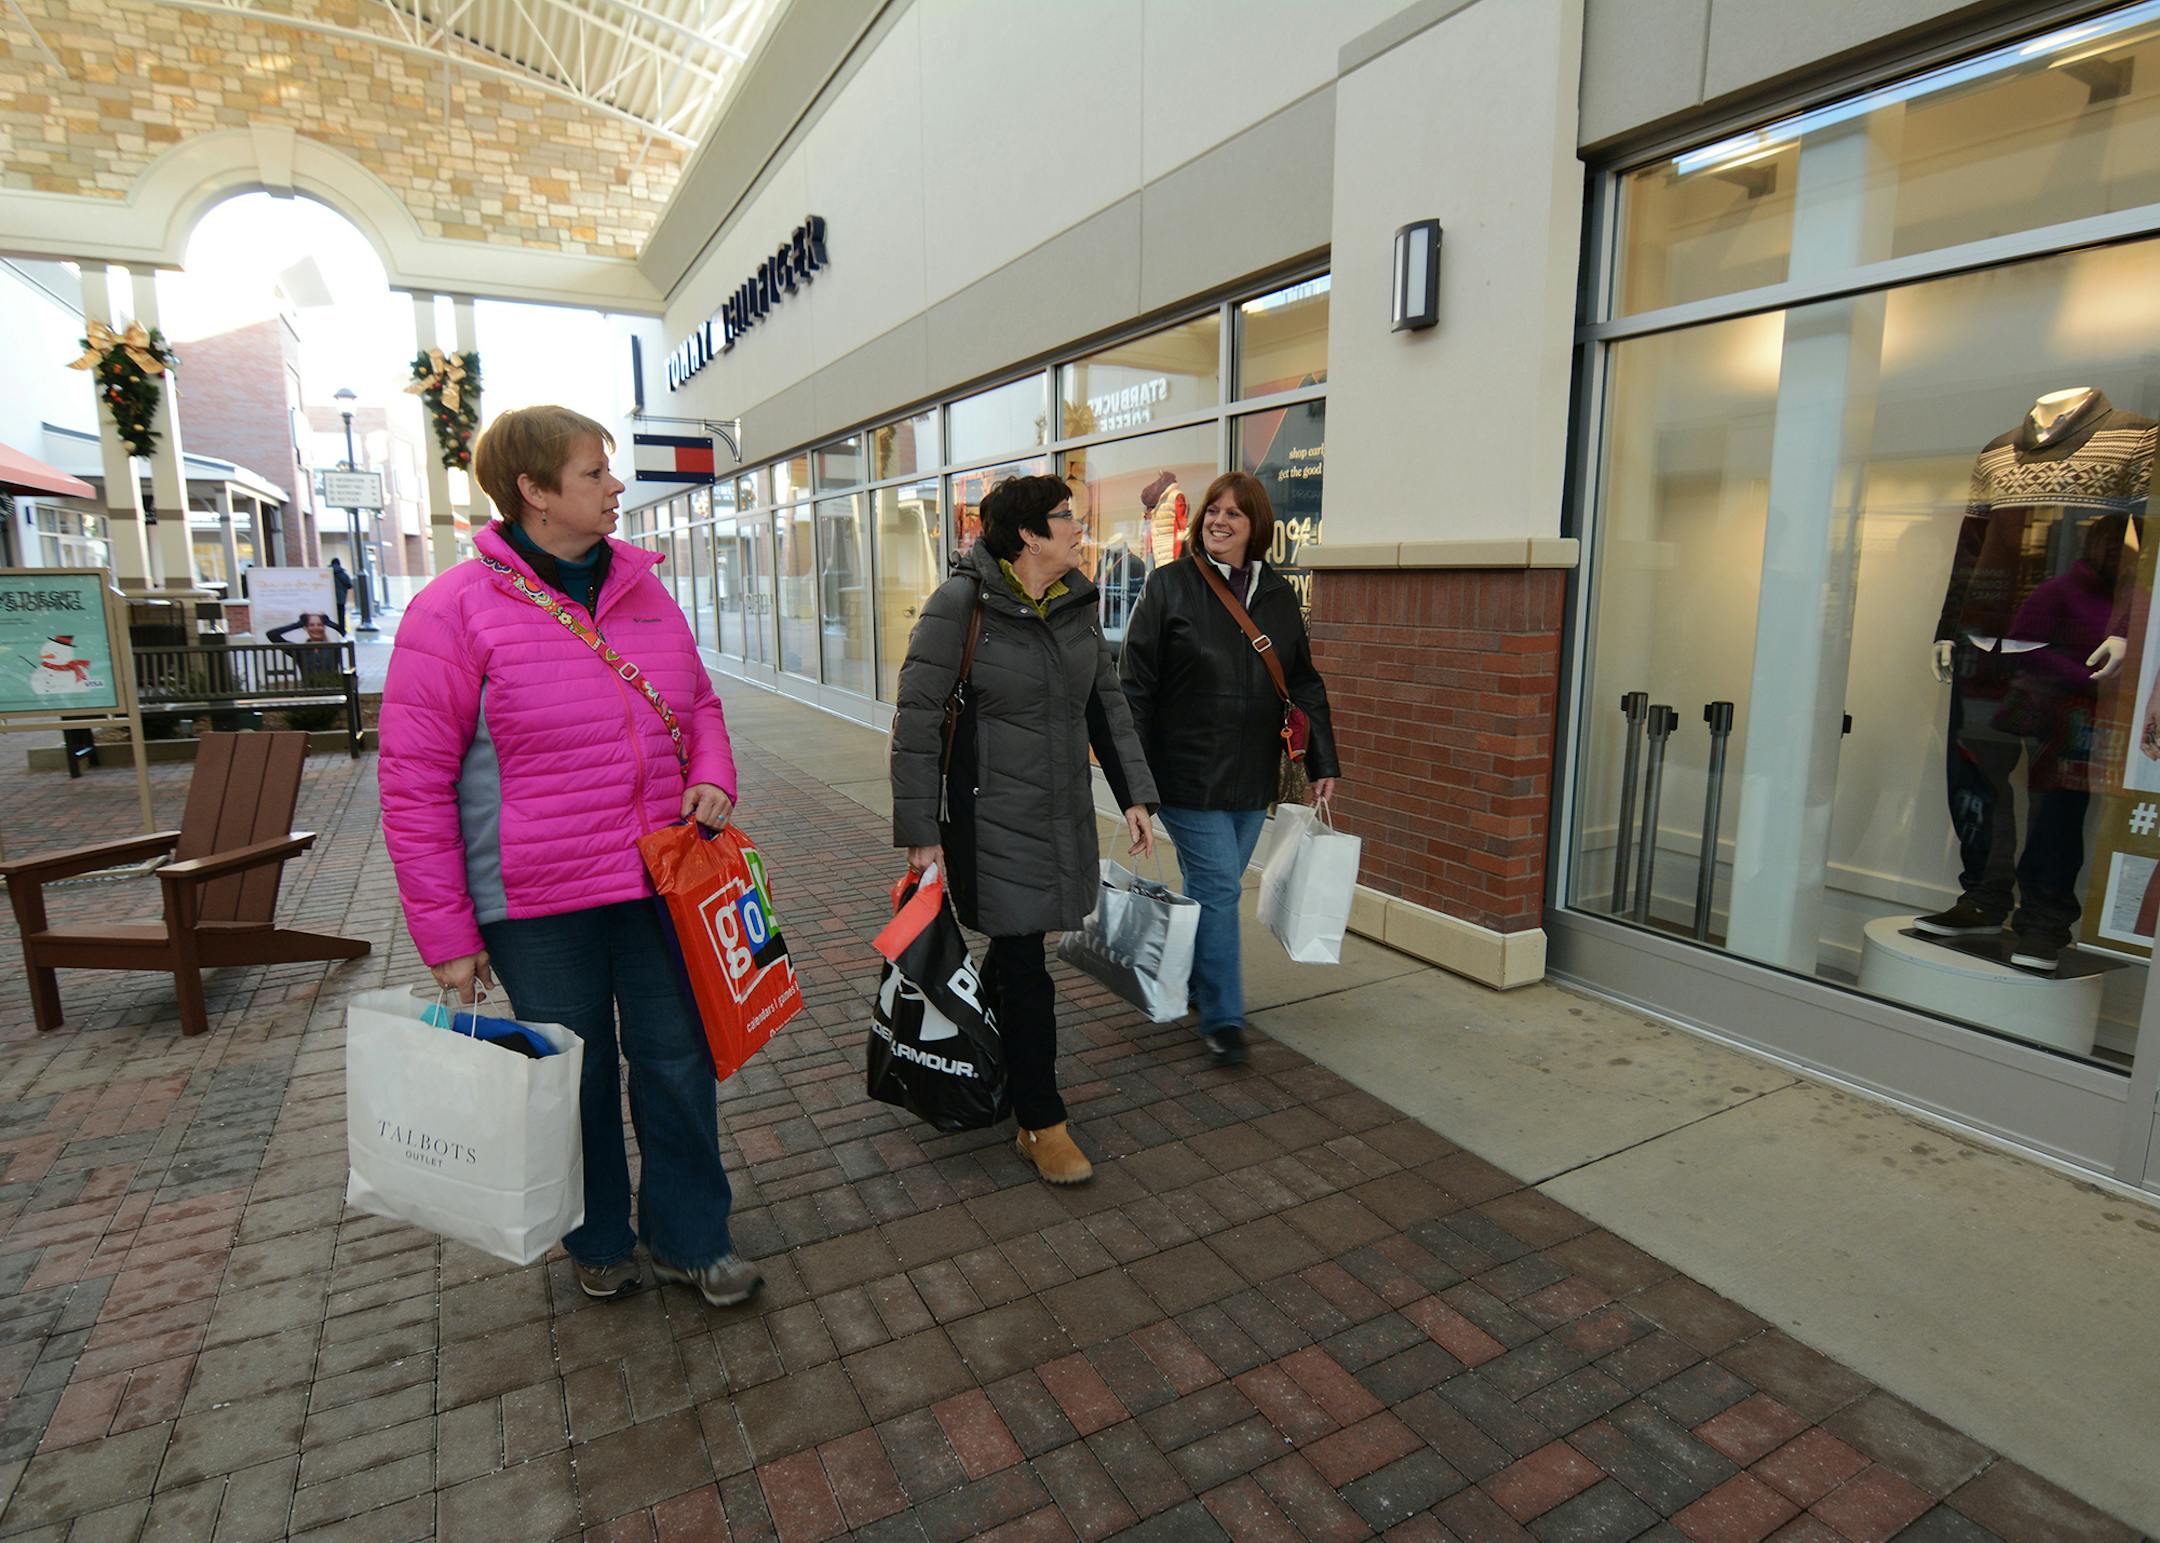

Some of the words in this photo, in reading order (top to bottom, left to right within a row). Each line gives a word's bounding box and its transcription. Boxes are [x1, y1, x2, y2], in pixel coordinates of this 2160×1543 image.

[664, 320, 713, 393] TOMMY
[722, 214, 830, 345] HILFIGER
[1289, 446, 1307, 460] shop
[1308, 443, 1325, 457] earl
[1278, 468, 1290, 482] get
[1290, 466, 1302, 478] the
[1302, 462, 1322, 479] good
[17, 591, 46, 602] THE
[49, 590, 82, 602] GIFT
[5, 600, 86, 612] SHOPPING.
[378, 1119, 477, 1165] TALBOTS
[406, 1150, 443, 1167] OUTLET
